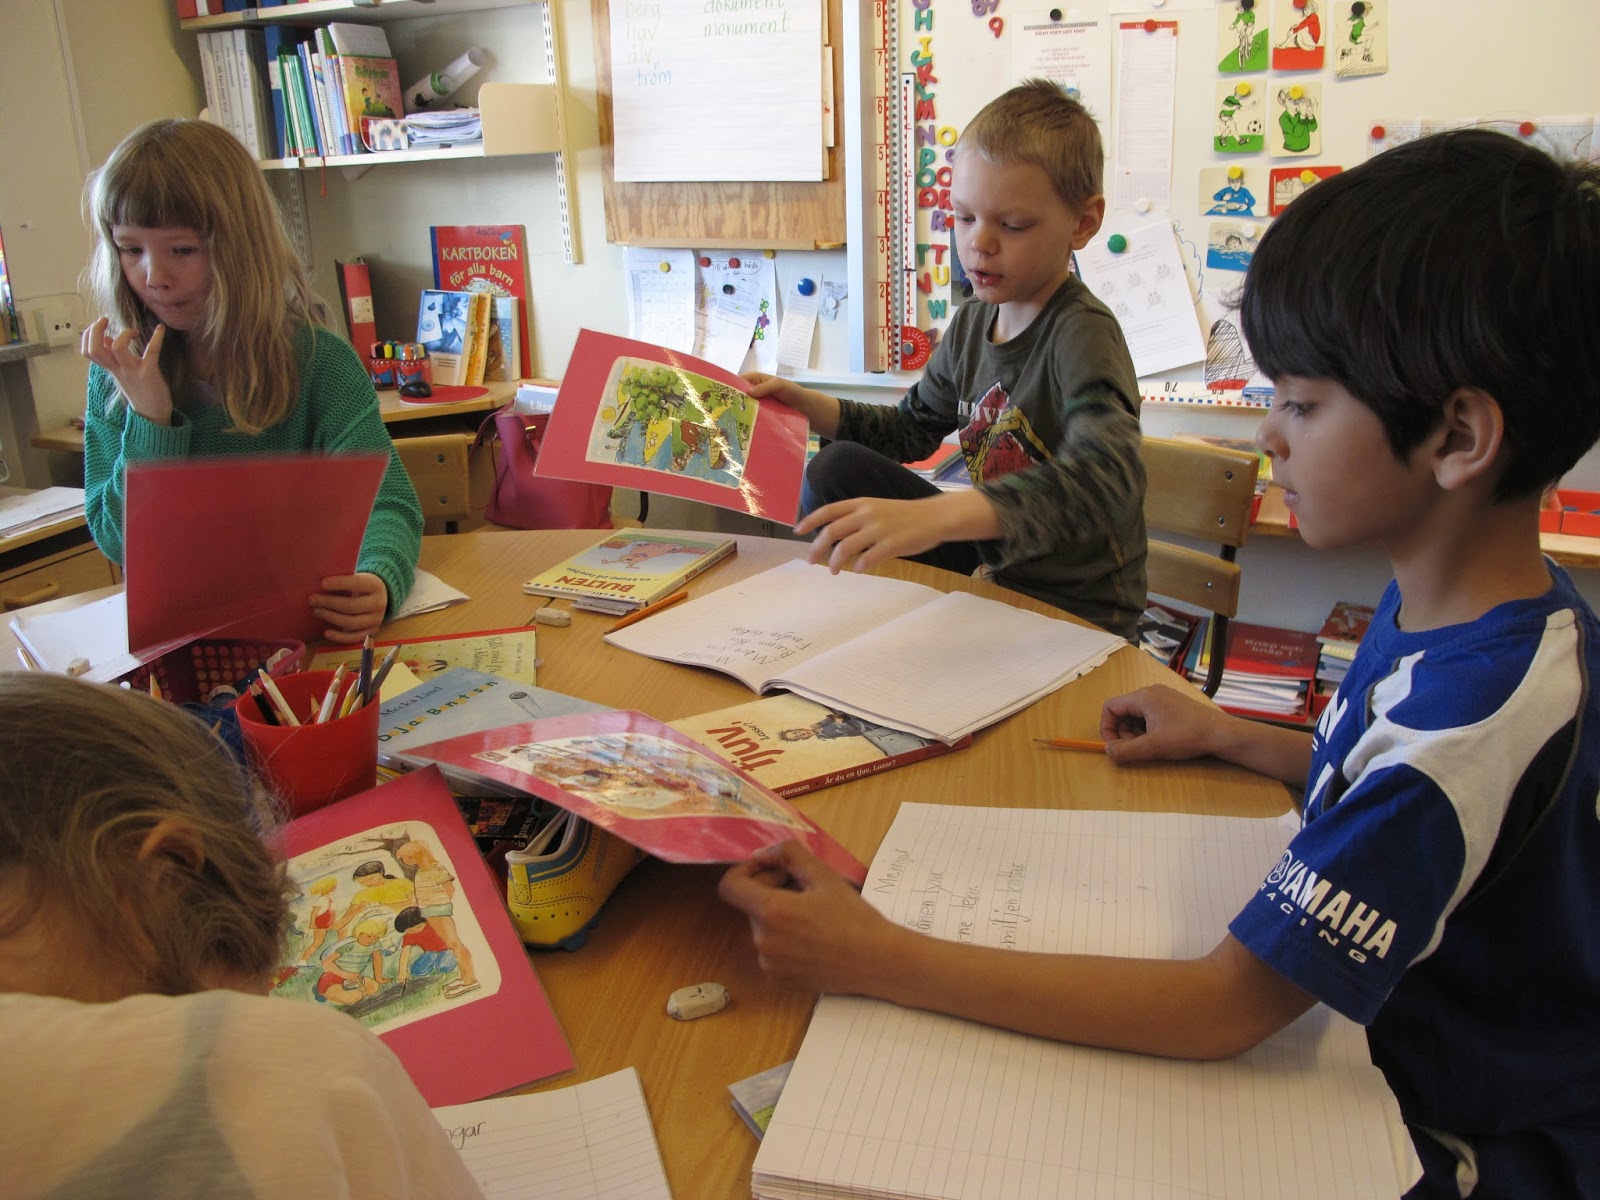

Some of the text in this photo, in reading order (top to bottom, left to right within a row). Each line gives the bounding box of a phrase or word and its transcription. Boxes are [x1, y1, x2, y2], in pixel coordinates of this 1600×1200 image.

[704, 11, 793, 37] monument
[442, 246, 518, 261] KARTBOKEN
[450, 262, 514, 287] för alla barn
[555, 575, 636, 593] BULTEN
[380, 685, 443, 718] Mecka Lind
[825, 776, 834, 785] Är
[857, 768, 872, 776] tjuv,
[873, 760, 897, 771] Lasse?
[907, 900, 935, 935] ånen
[1278, 859, 1398, 960] YAMAHA
[1260, 882, 1368, 964] RACING
